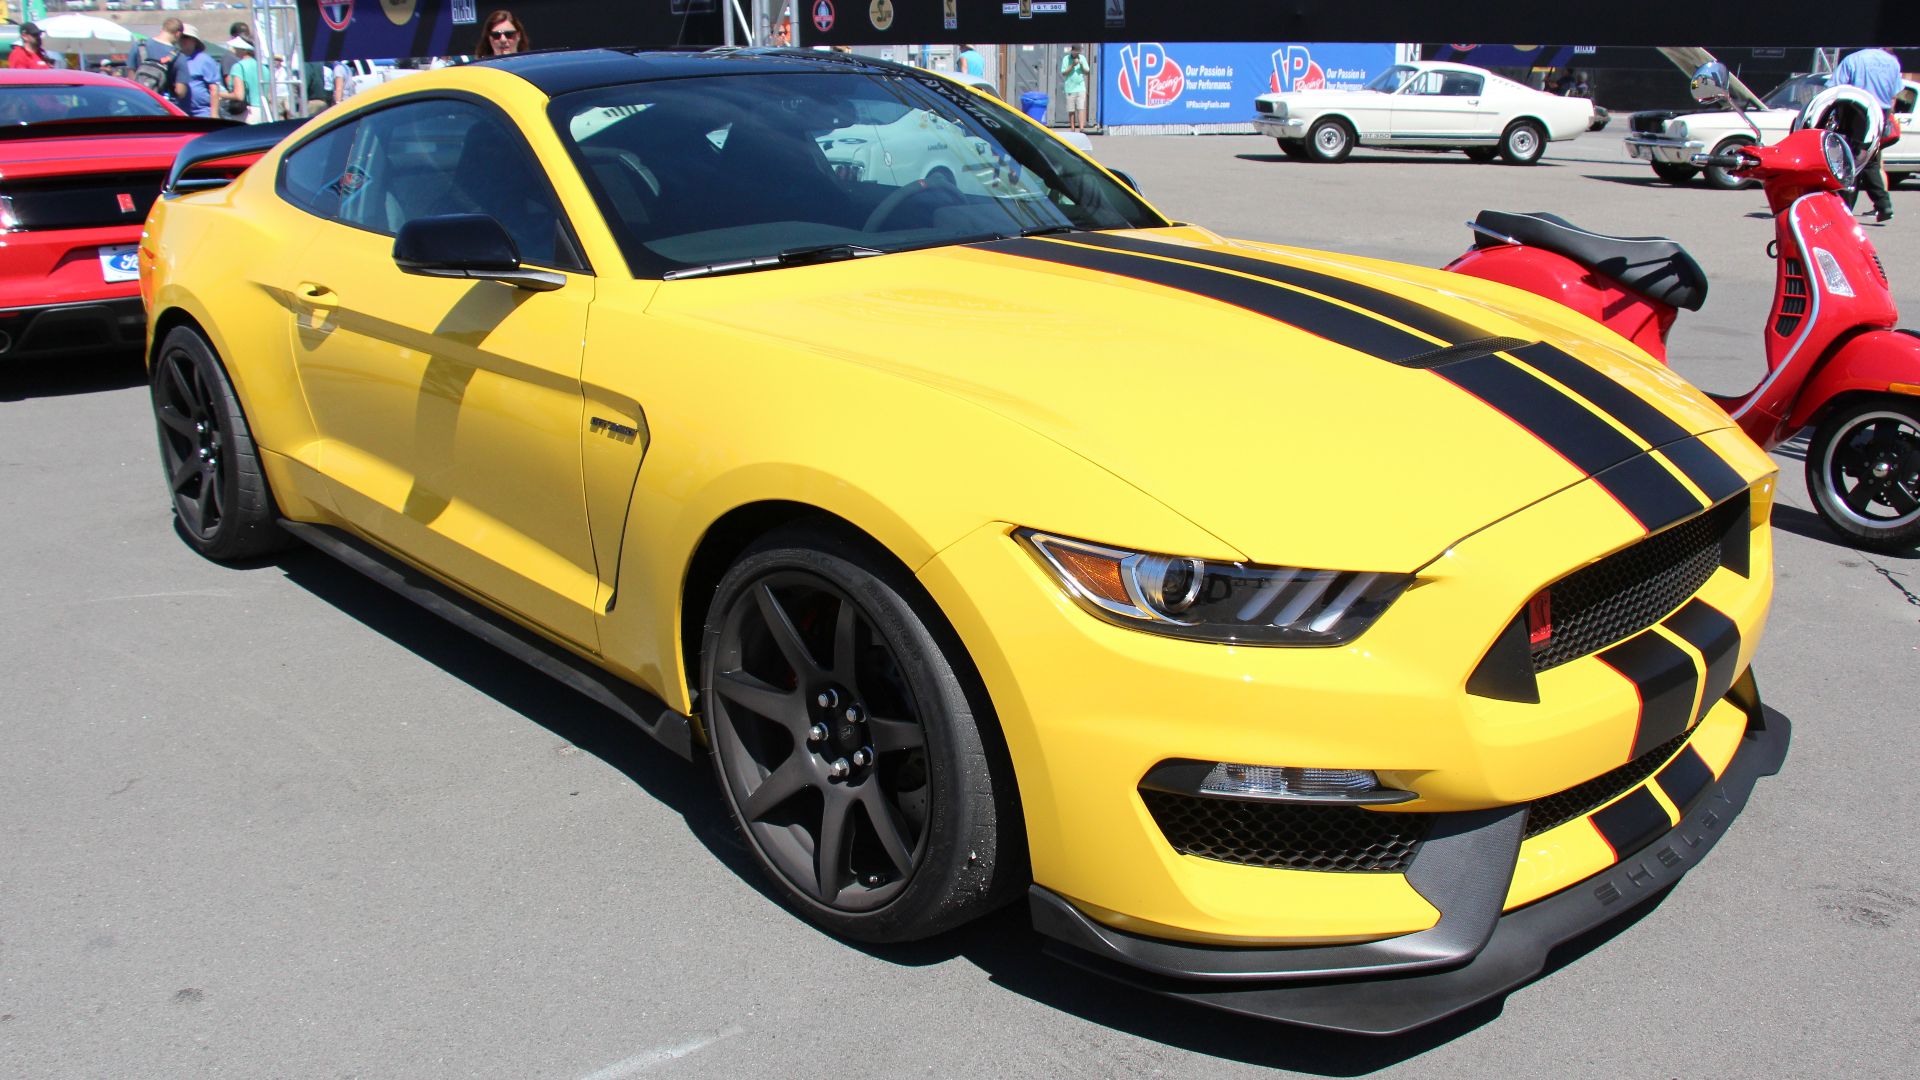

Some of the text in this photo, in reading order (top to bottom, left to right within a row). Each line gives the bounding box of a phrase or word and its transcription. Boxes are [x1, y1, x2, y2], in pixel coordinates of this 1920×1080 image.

[1120, 42, 1166, 107] VP
[1185, 65, 1233, 77] Our Passion is
[1271, 45, 1311, 92] VP
[1326, 68, 1366, 79] Our Passion is
[1149, 75, 1182, 98] Racing
[1185, 79, 1198, 90] Your
[1593, 786, 1733, 907] SHELBY
